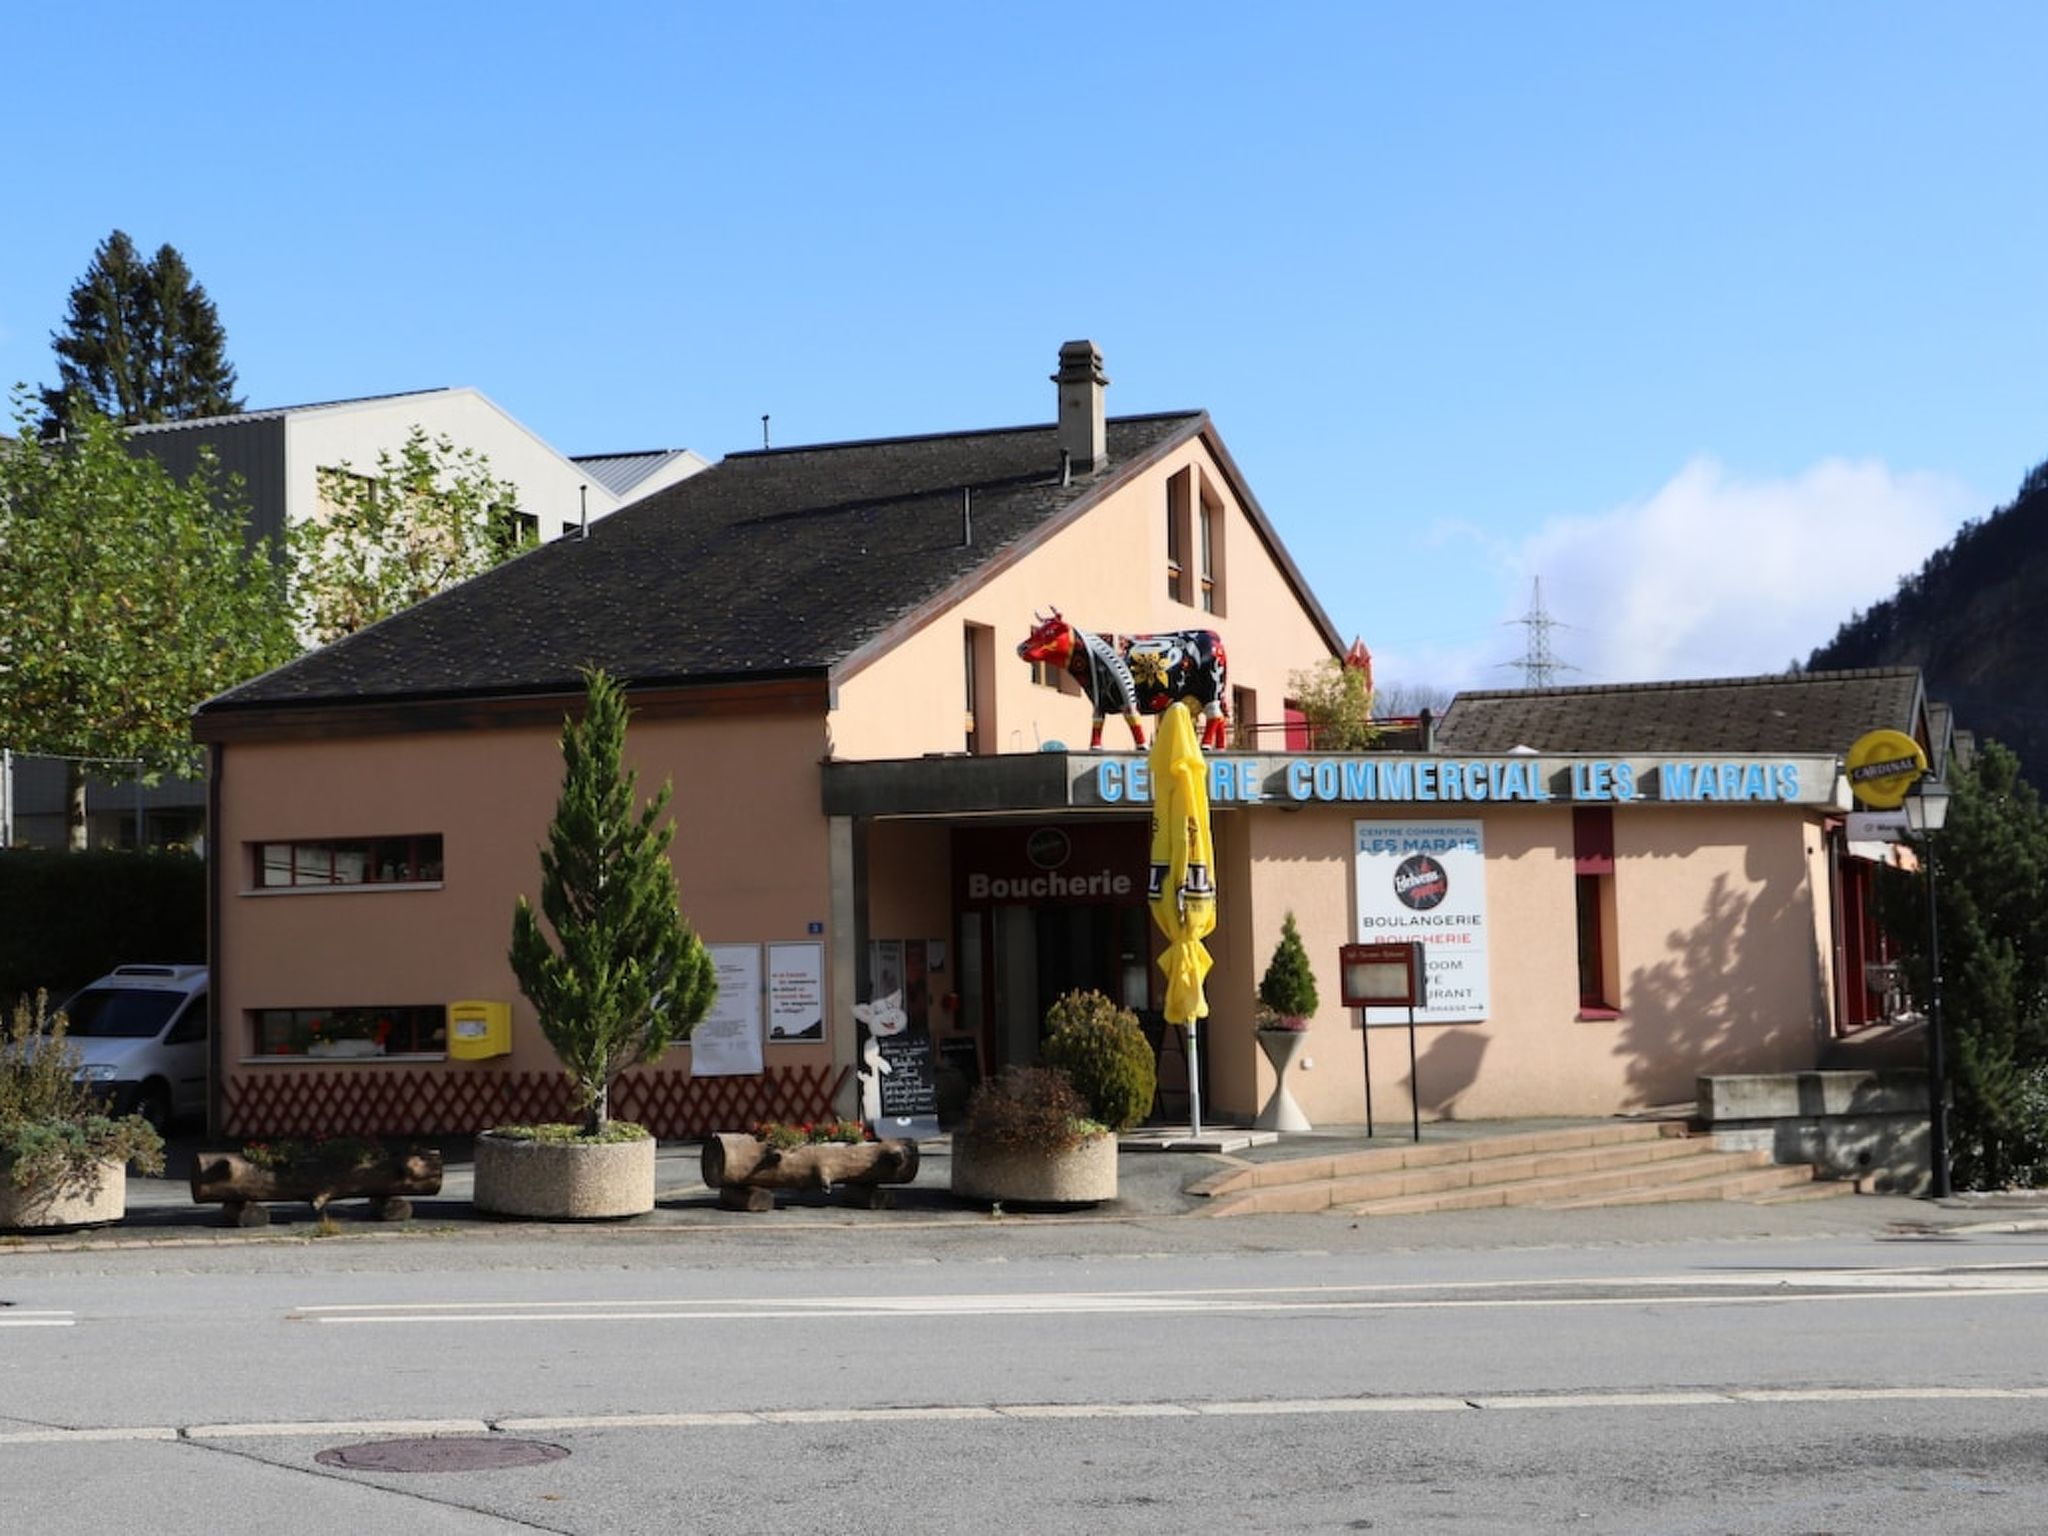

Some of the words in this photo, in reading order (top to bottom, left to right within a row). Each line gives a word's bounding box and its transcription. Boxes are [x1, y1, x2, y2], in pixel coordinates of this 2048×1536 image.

[1854, 758, 1915, 779] CARDINAL
[1097, 758, 1260, 801] CERE
[1288, 759, 1547, 801] COMMERCIAL
[1572, 760, 1635, 801] LES
[1660, 761, 1801, 801] MARAIS
[1359, 827, 1402, 837] CENTRE
[1405, 827, 1478, 837] COMMERCIAL
[1360, 838, 1398, 852] LES
[1403, 838, 1479, 852] MARAIS
[968, 869, 1132, 899] Boucherie
[1363, 914, 1482, 928] BOULANGERIE
